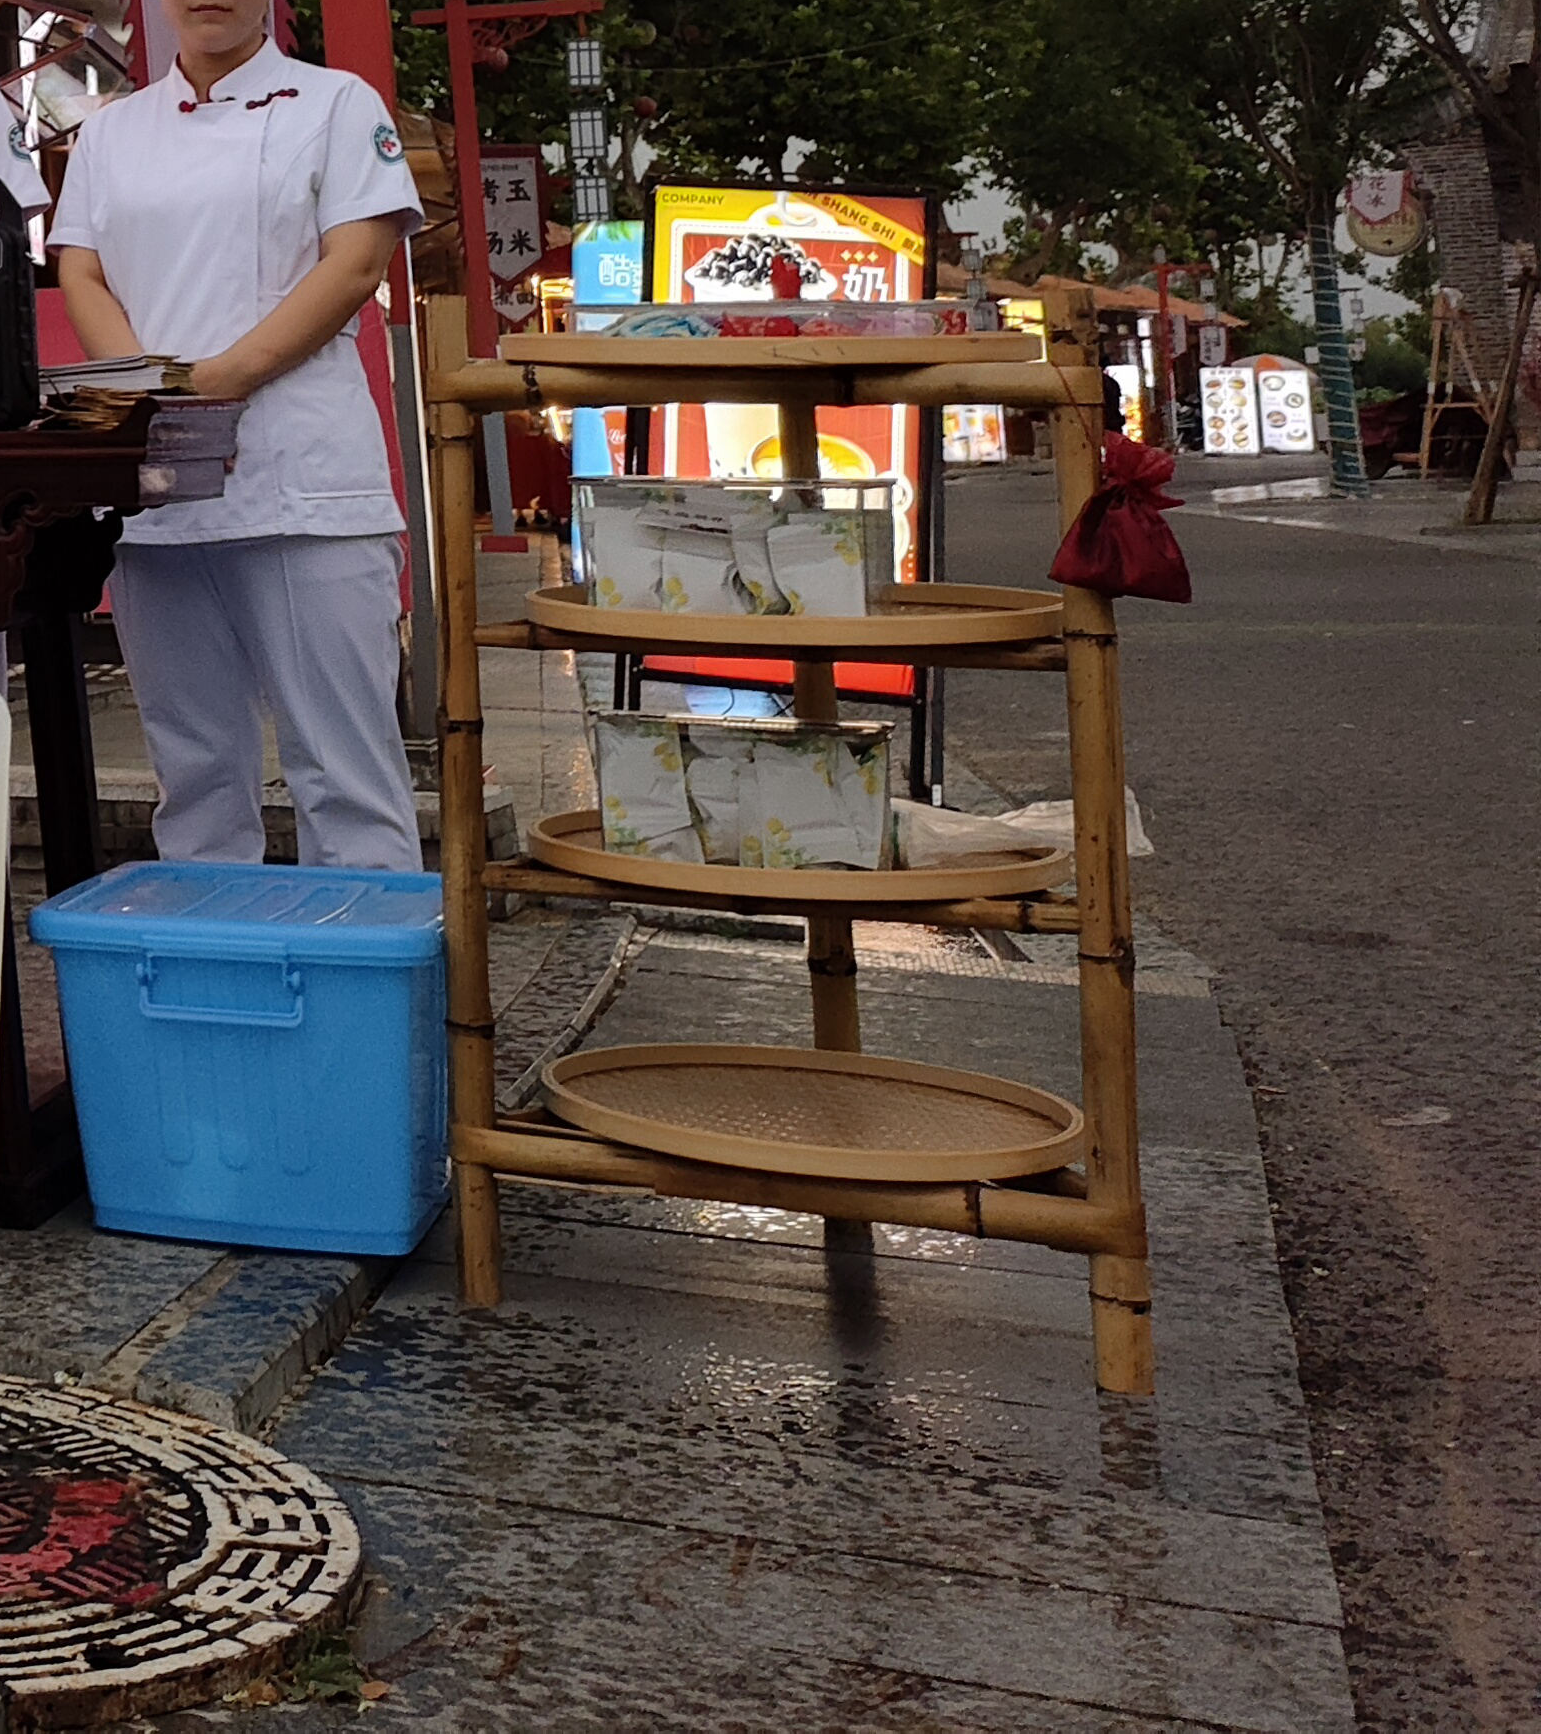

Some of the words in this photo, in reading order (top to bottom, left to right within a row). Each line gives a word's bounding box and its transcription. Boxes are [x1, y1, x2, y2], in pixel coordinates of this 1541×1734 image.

[662, 192, 724, 206] COMPANY
[821, 196, 869, 226] SHANG
[871, 221, 896, 240] SHI
[842, 263, 888, 302] 奶
